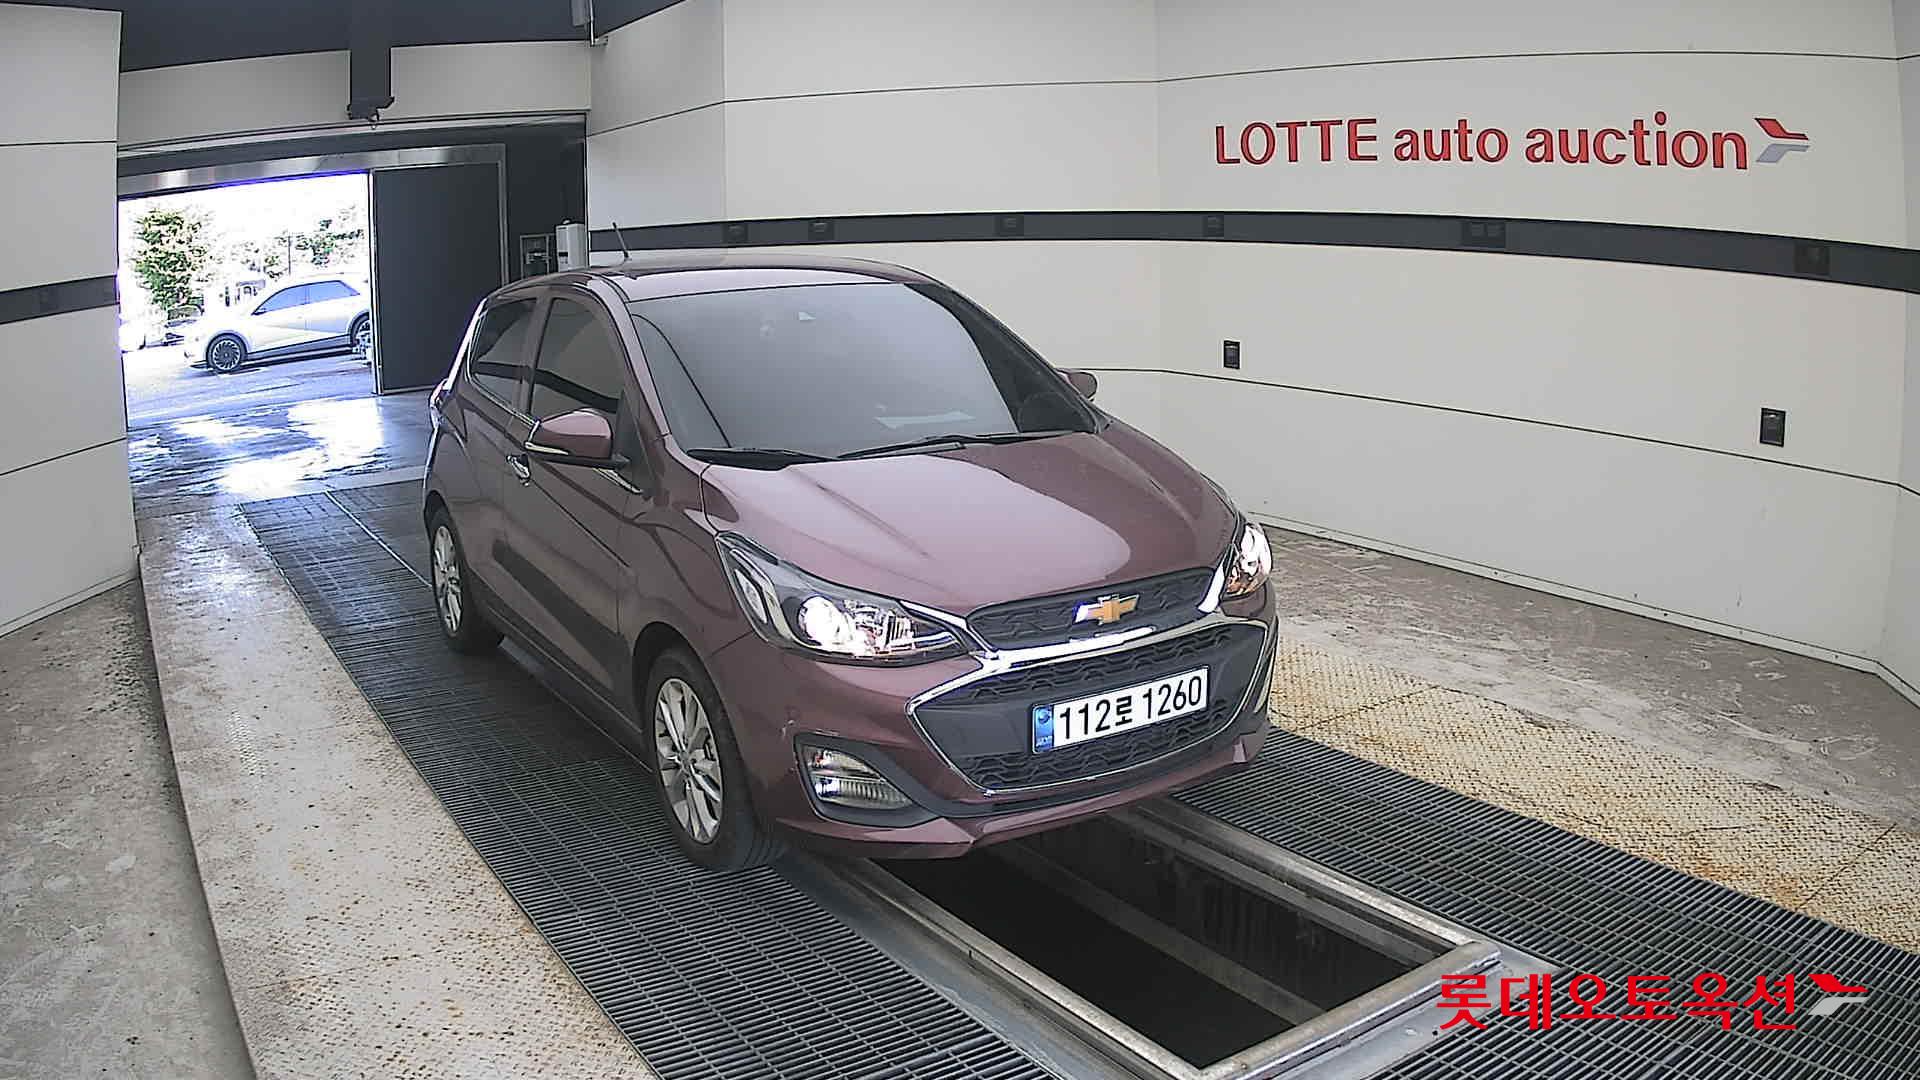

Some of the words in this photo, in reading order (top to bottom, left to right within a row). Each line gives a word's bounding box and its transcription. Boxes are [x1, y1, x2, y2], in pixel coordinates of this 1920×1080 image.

[1215, 118, 1378, 165] LOTTE
[1393, 118, 1509, 162] auto
[1524, 111, 1748, 170] auction
[1059, 695, 1133, 740] 112로
[1142, 676, 1202, 719] 1260
